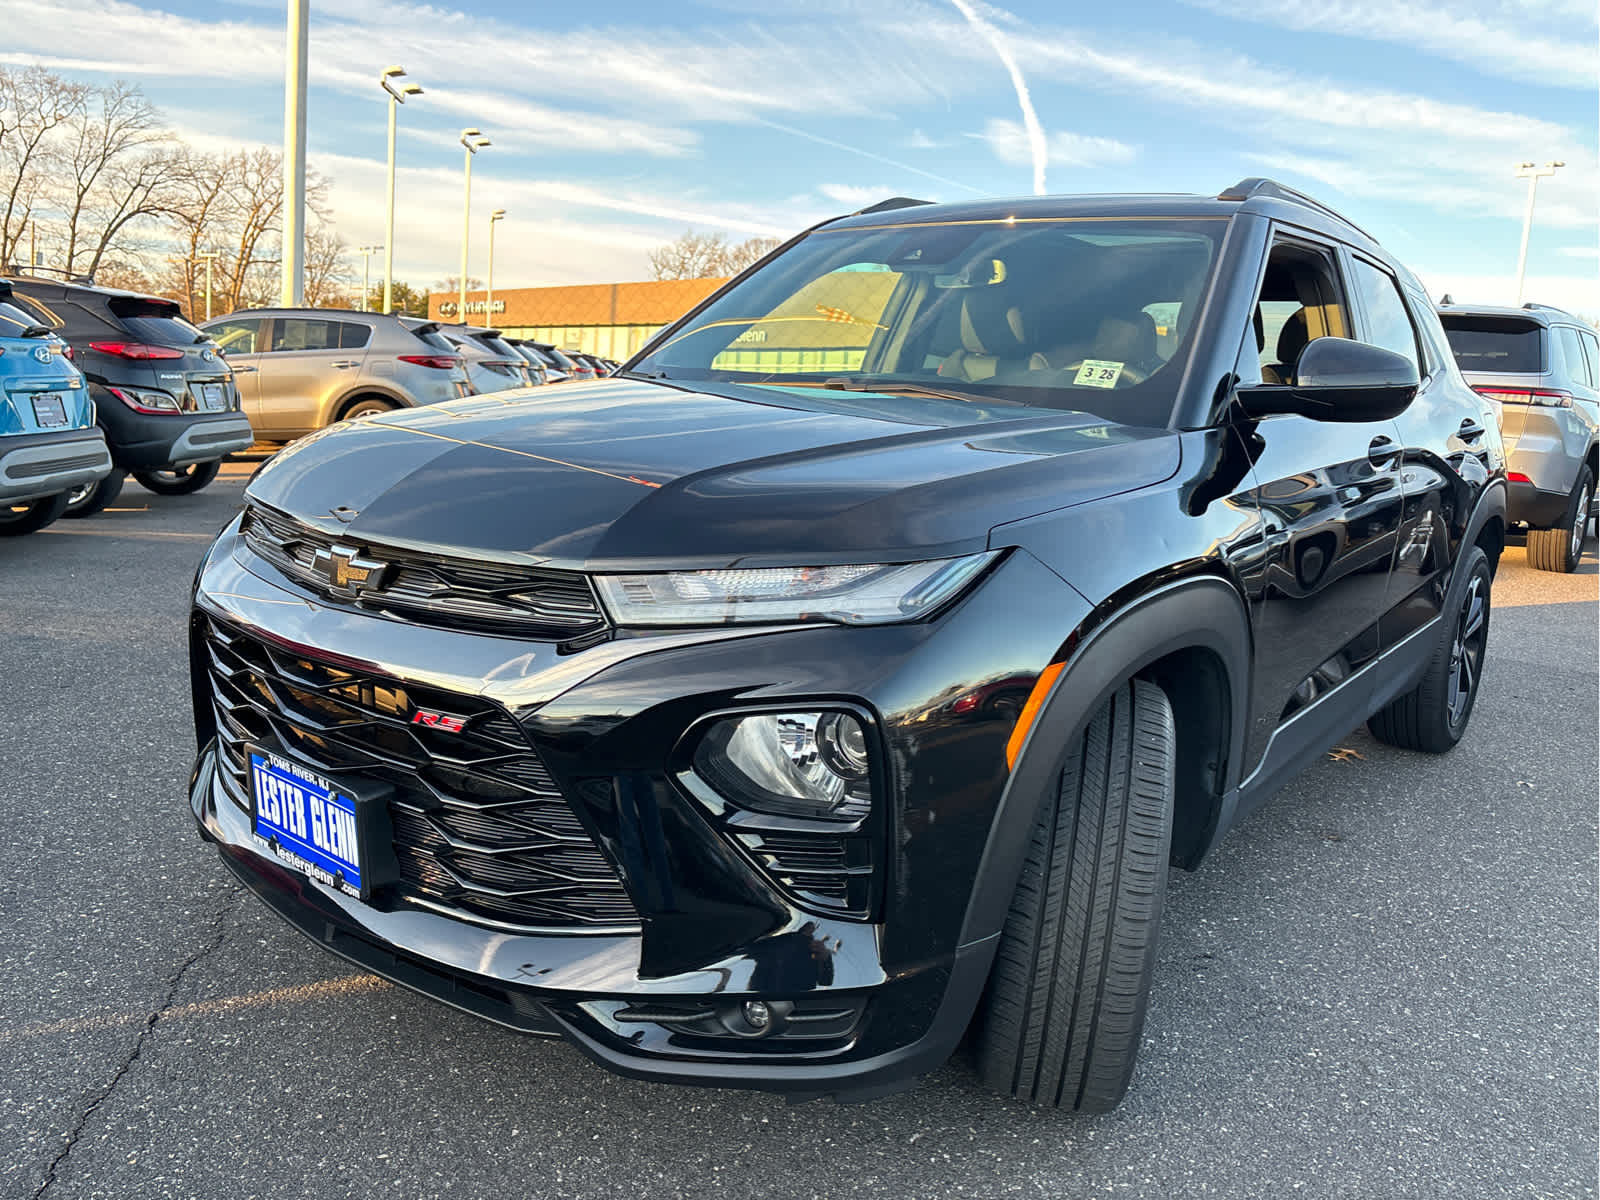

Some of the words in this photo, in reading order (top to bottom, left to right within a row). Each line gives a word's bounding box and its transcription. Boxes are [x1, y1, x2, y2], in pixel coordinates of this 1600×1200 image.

[1084, 367, 1094, 378] 3
[1098, 369, 1116, 380] 28
[412, 710, 467, 733] RS
[268, 754, 291, 773] TOMS
[318, 778, 330, 791] NJ
[253, 767, 307, 840] LESTER
[310, 794, 360, 868] GLENN
